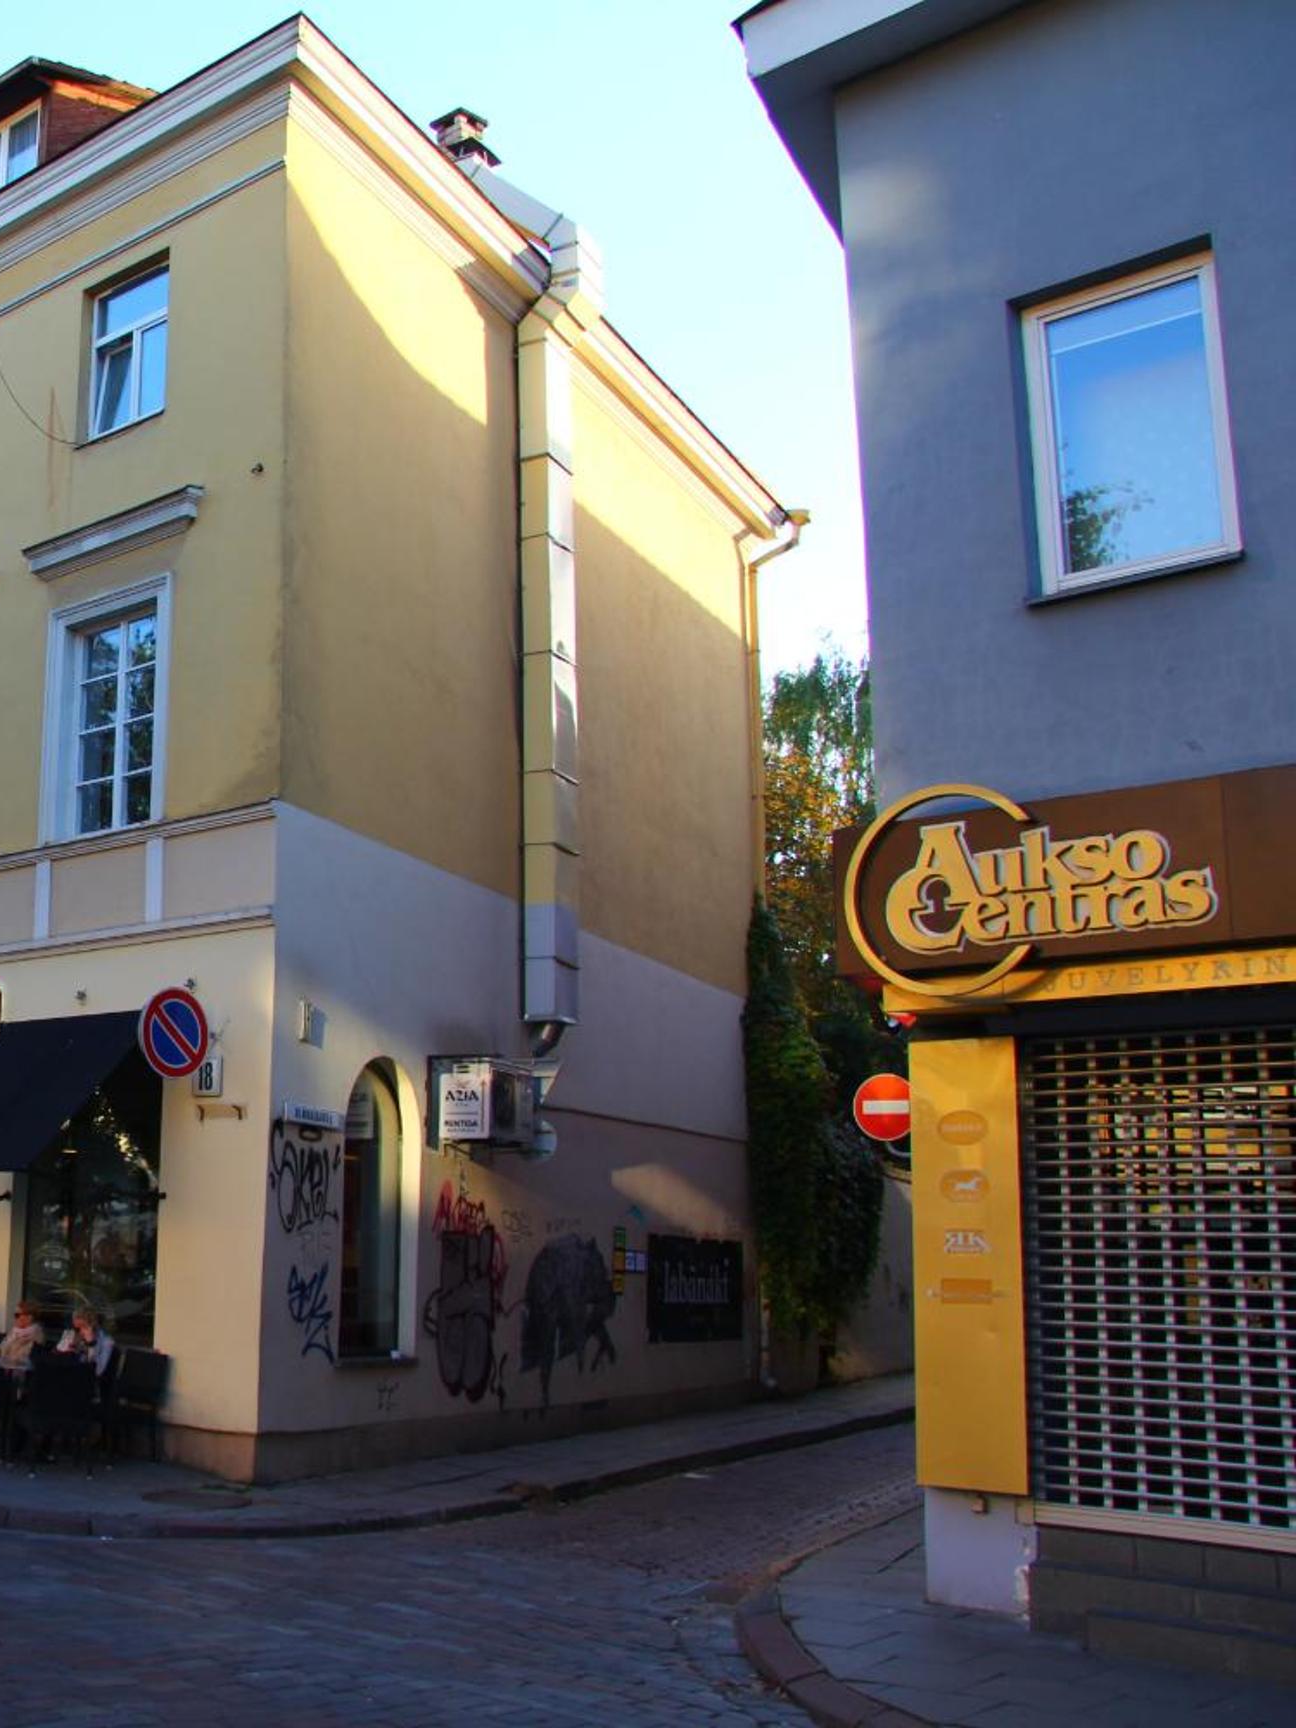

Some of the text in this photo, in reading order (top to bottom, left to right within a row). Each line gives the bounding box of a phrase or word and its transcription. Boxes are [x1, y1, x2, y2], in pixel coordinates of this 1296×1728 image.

[917, 821, 1171, 898] Aukso
[886, 866, 1218, 954] Centras
[198, 1061, 215, 1091] 18
